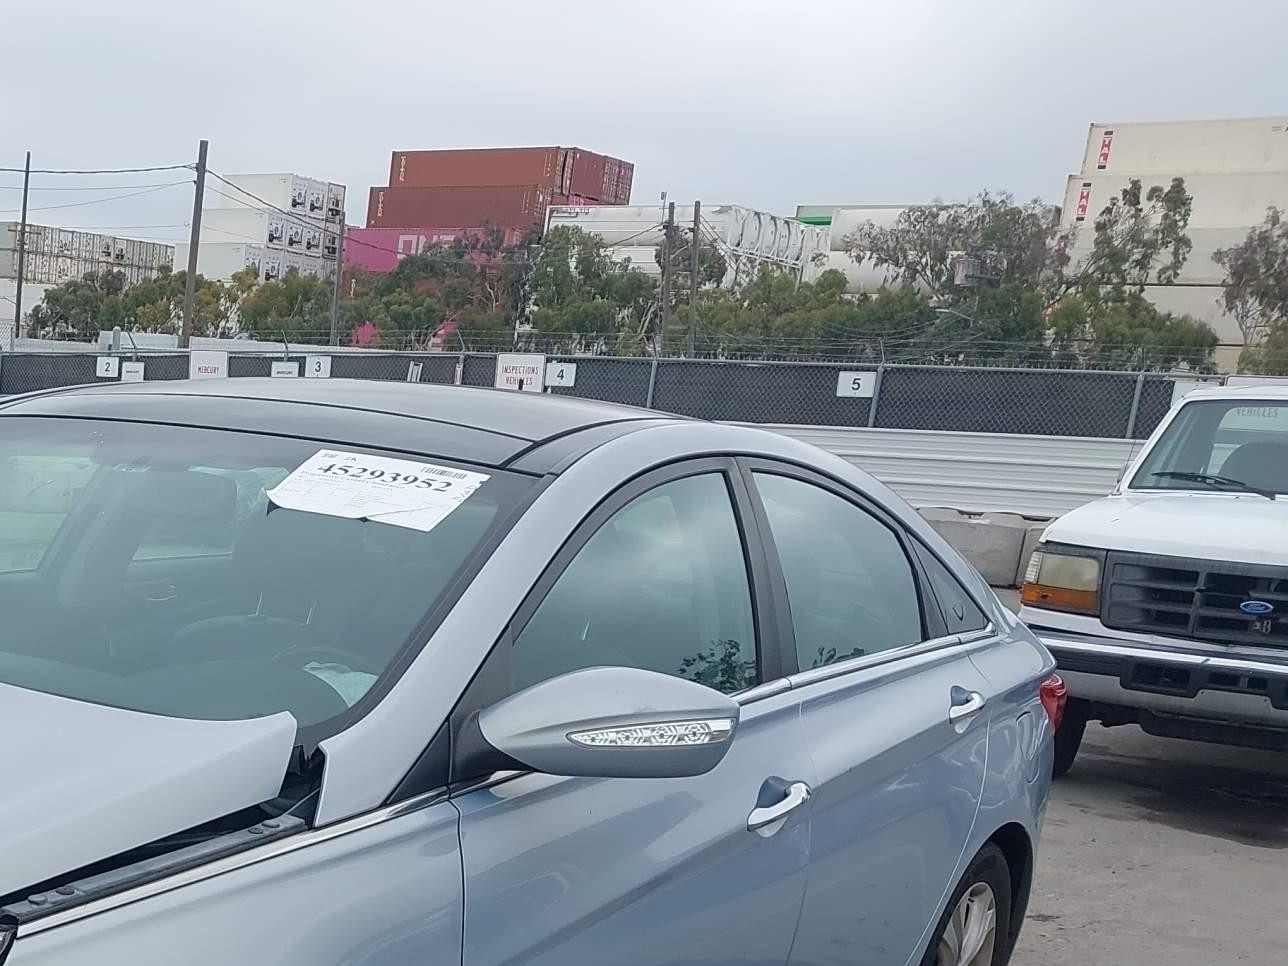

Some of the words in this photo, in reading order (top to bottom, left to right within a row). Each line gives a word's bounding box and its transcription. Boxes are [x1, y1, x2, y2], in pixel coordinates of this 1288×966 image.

[104, 361, 111, 372] 2
[197, 366, 220, 374] MERCURY
[314, 361, 322, 373] 3
[501, 365, 540, 376] INSPECTIONS
[556, 368, 565, 381] 4
[505, 376, 534, 386] VEHILES
[851, 377, 862, 391] 5
[1236, 407, 1280, 418] VEHICLES
[316, 463, 454, 492] 45293952
